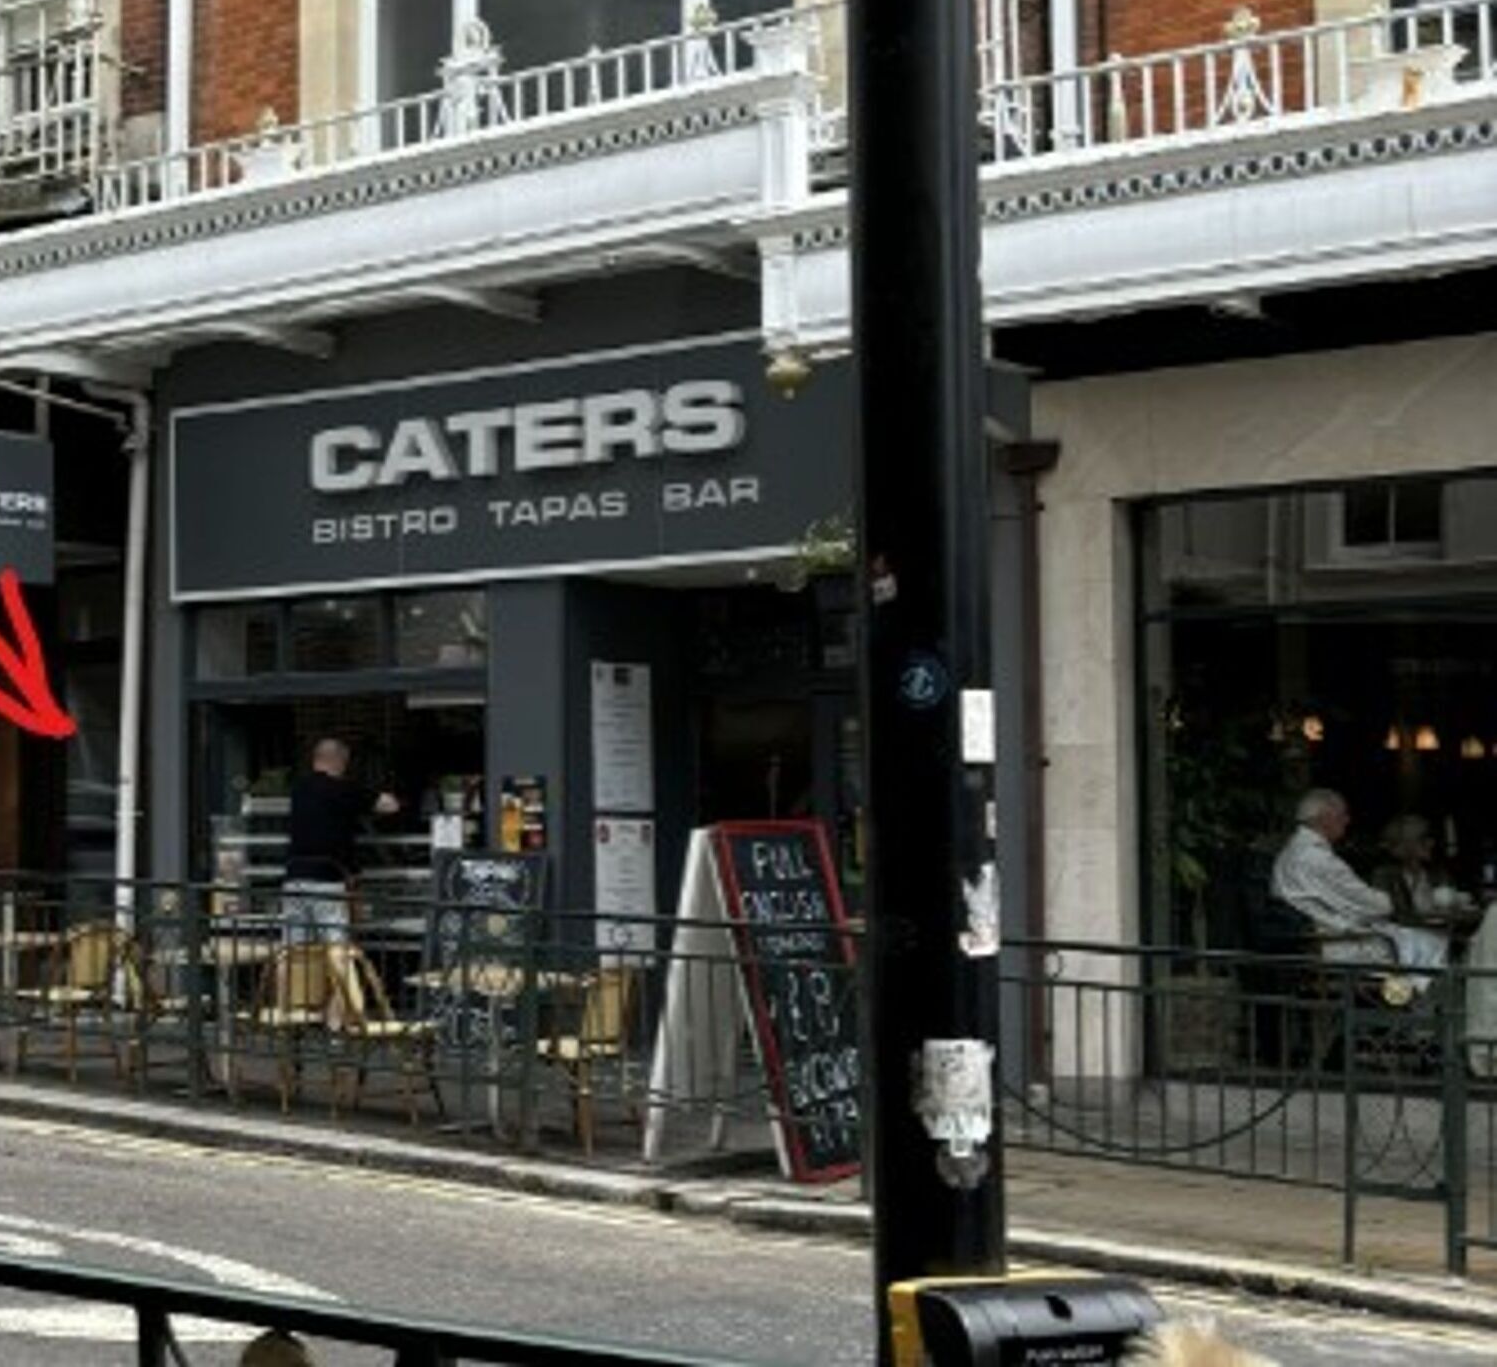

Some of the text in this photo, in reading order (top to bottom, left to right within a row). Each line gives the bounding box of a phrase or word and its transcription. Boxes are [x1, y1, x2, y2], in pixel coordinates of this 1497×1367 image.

[309, 379, 747, 492] CATERS
[311, 476, 761, 545] BISTRO TAPAS BAR
